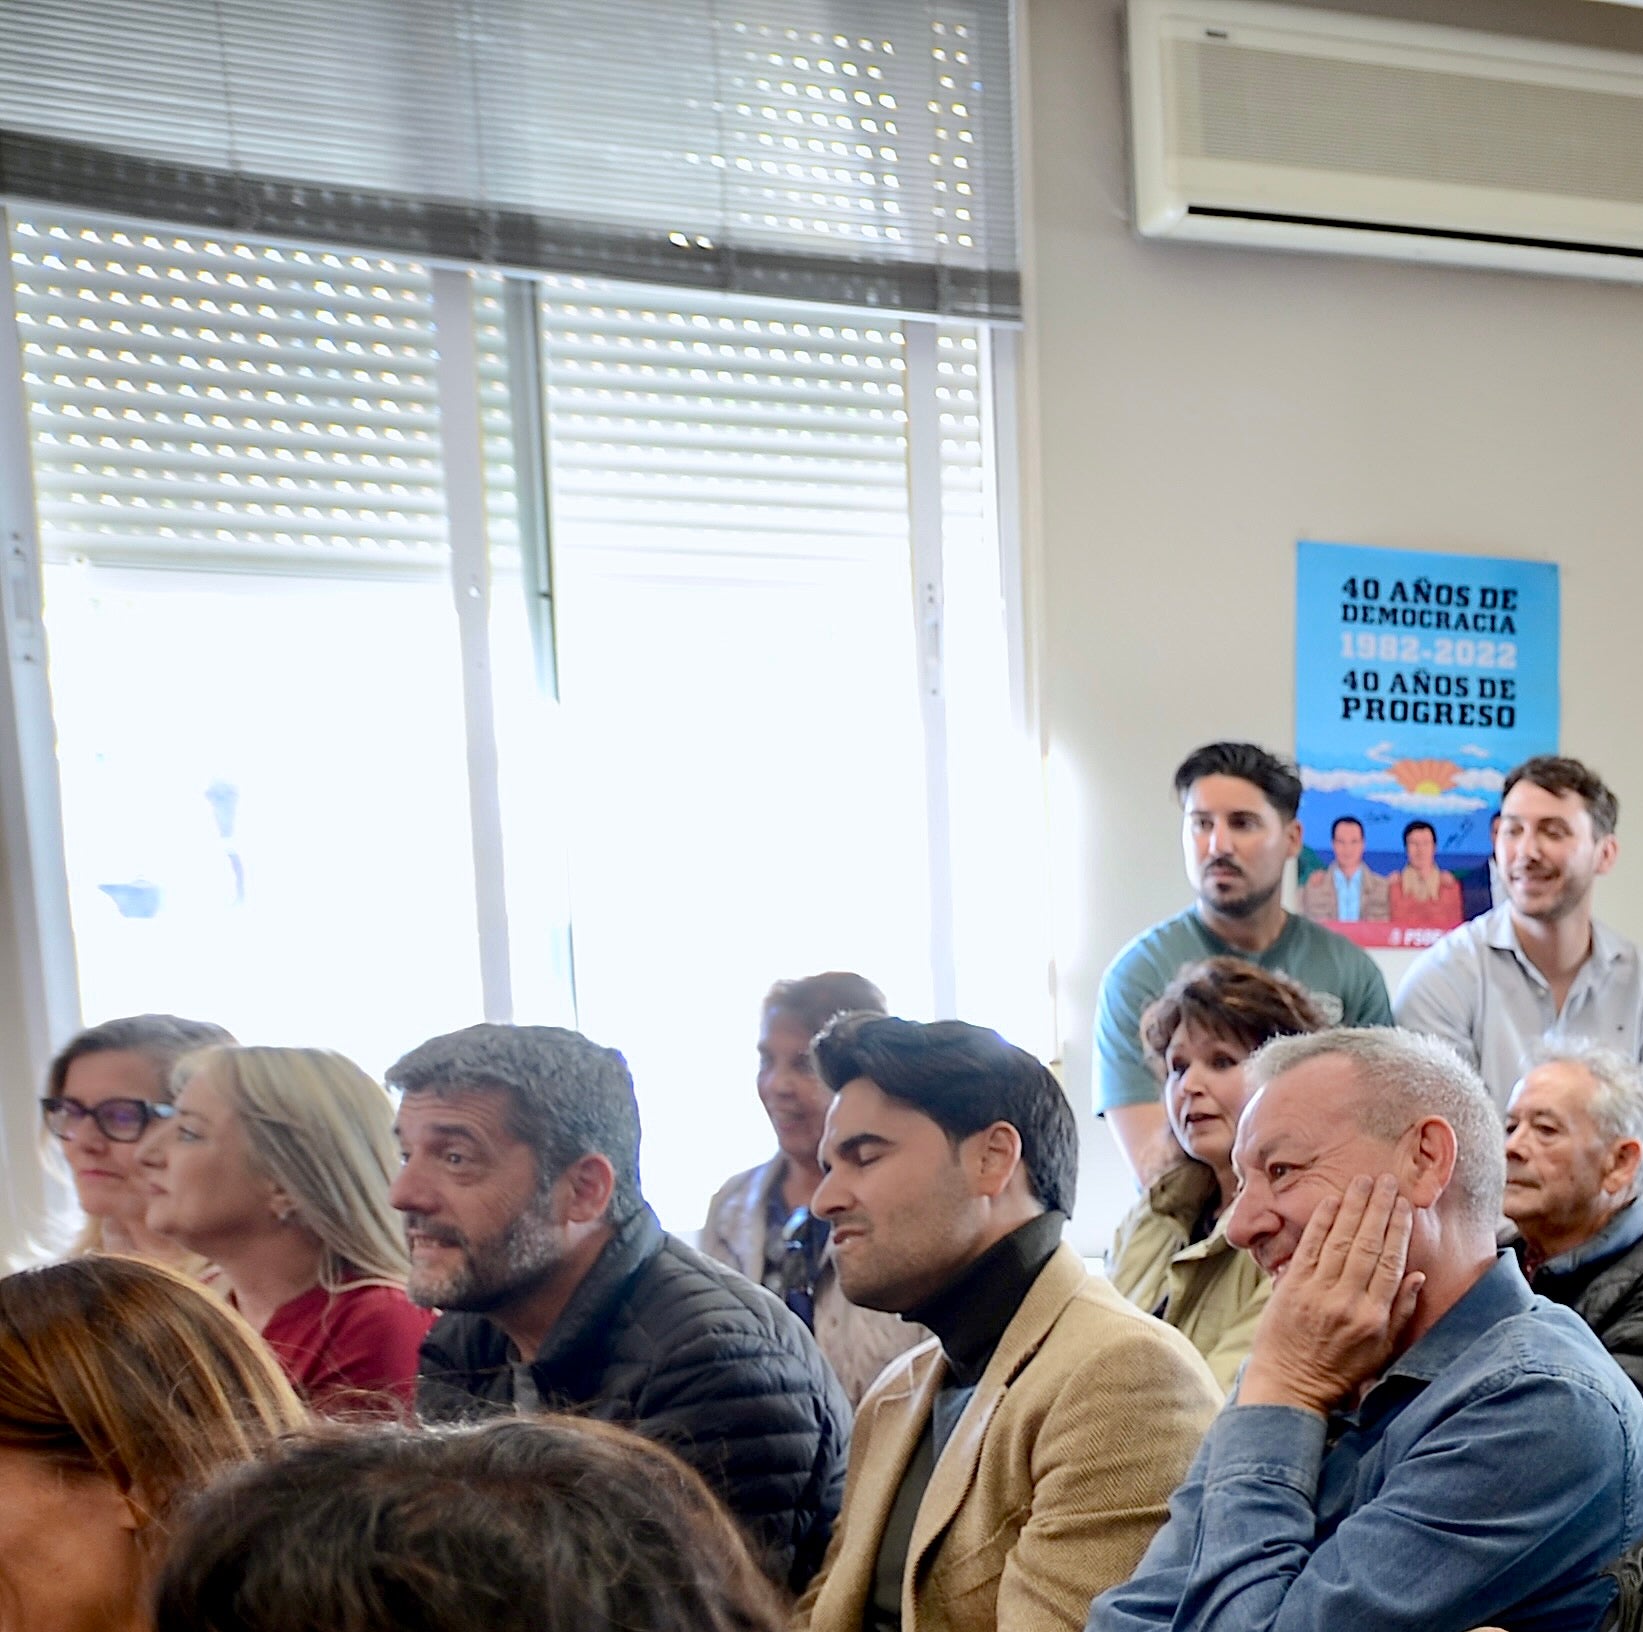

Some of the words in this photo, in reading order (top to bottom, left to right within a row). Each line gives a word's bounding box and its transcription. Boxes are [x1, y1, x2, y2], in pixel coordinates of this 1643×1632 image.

[1342, 576, 1380, 601] 40
[1389, 576, 1471, 608] AÑOS
[1479, 586, 1518, 611] DE
[1341, 603, 1517, 636] DEMOCRACIA
[1340, 630, 1518, 670] 1982-2022
[1342, 669, 1380, 692] 40
[1389, 667, 1470, 698] AÑOS
[1478, 677, 1517, 701] DE
[1341, 696, 1516, 729] PROGRESO
